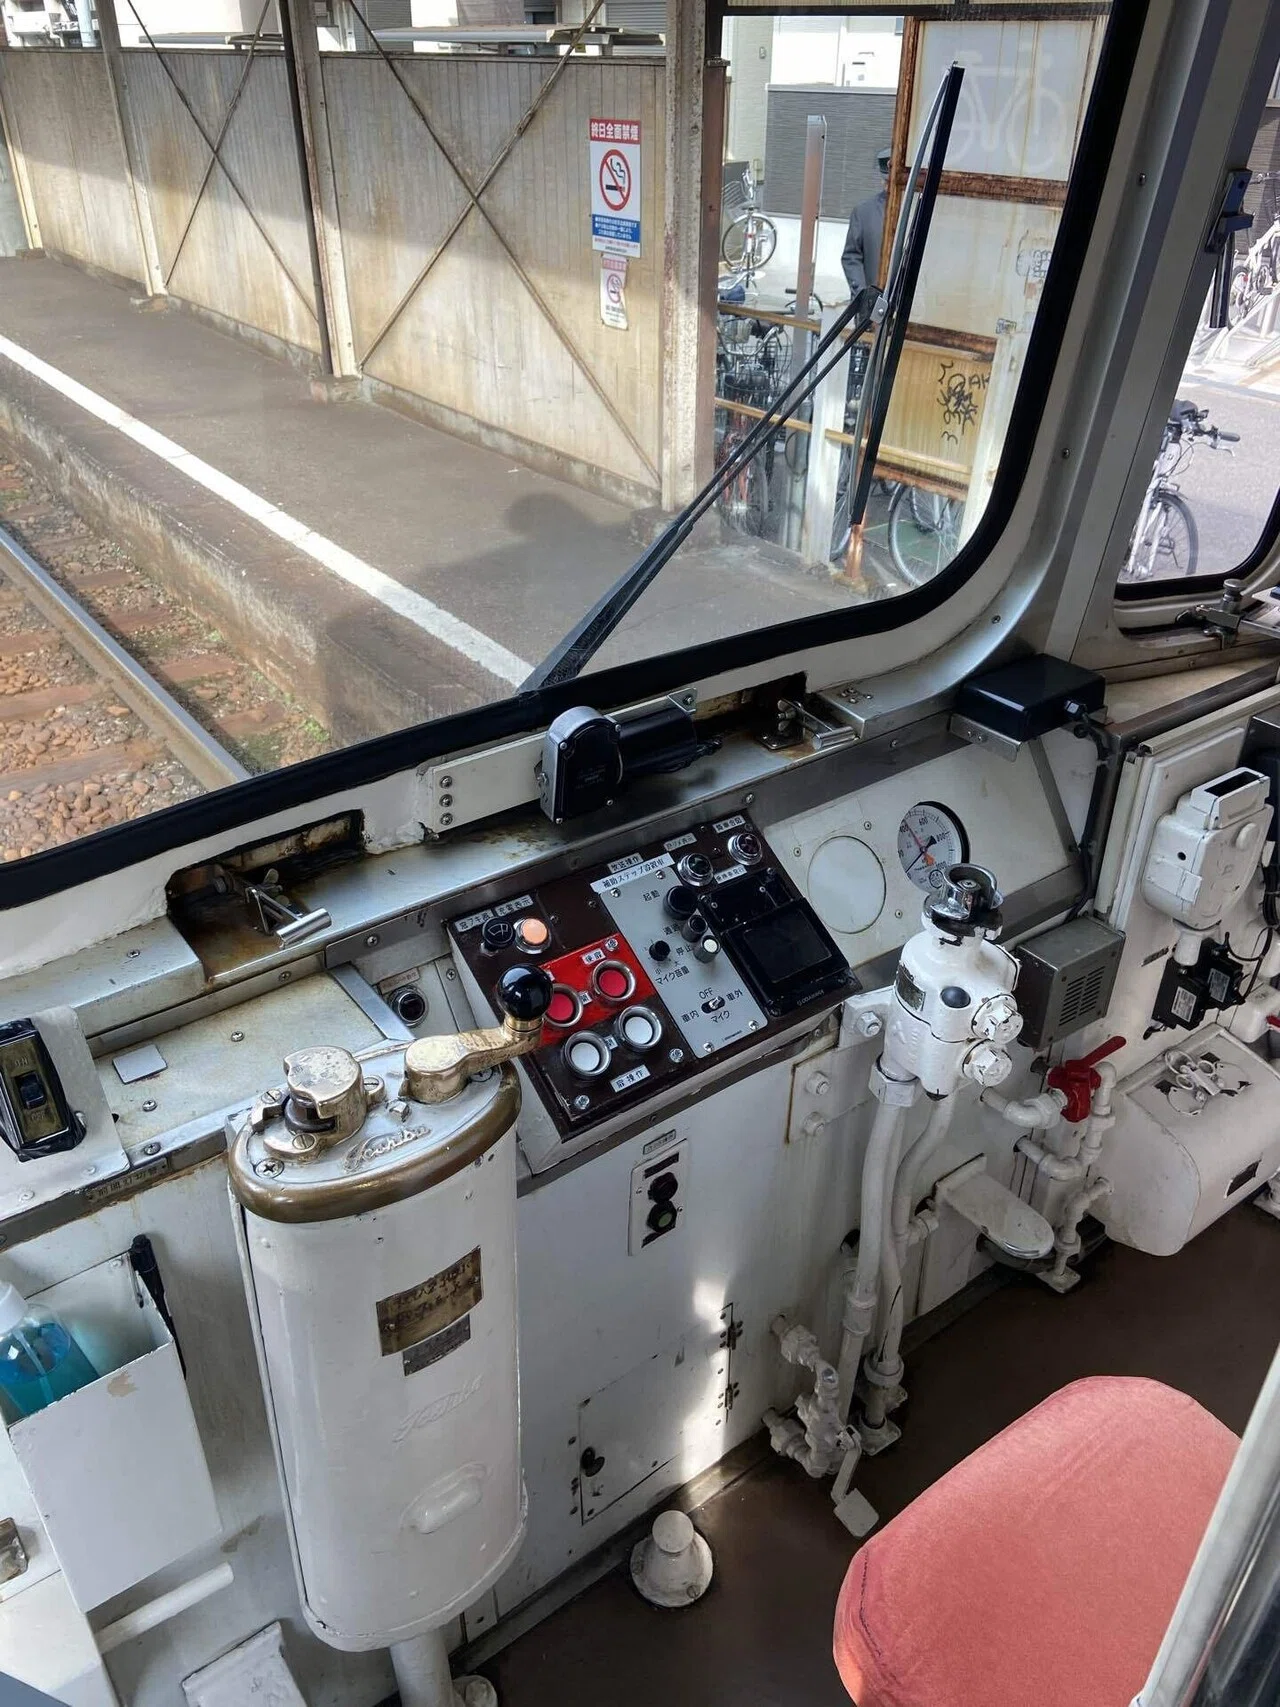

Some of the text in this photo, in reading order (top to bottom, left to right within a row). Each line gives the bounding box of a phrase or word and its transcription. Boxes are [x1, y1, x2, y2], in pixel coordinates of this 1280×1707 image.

[591, 122, 639, 141] 終日全面禁煙
[603, 859, 664, 888] 補助ステップ設置車
[643, 890, 660, 901] 起動
[676, 945, 692, 956] 停止
[655, 965, 690, 985] マイク音量
[699, 987, 713, 999] OFF
[726, 989, 743, 1000] 車外
[681, 1010, 699, 1023] 車内
[711, 1010, 730, 1023] マイク
